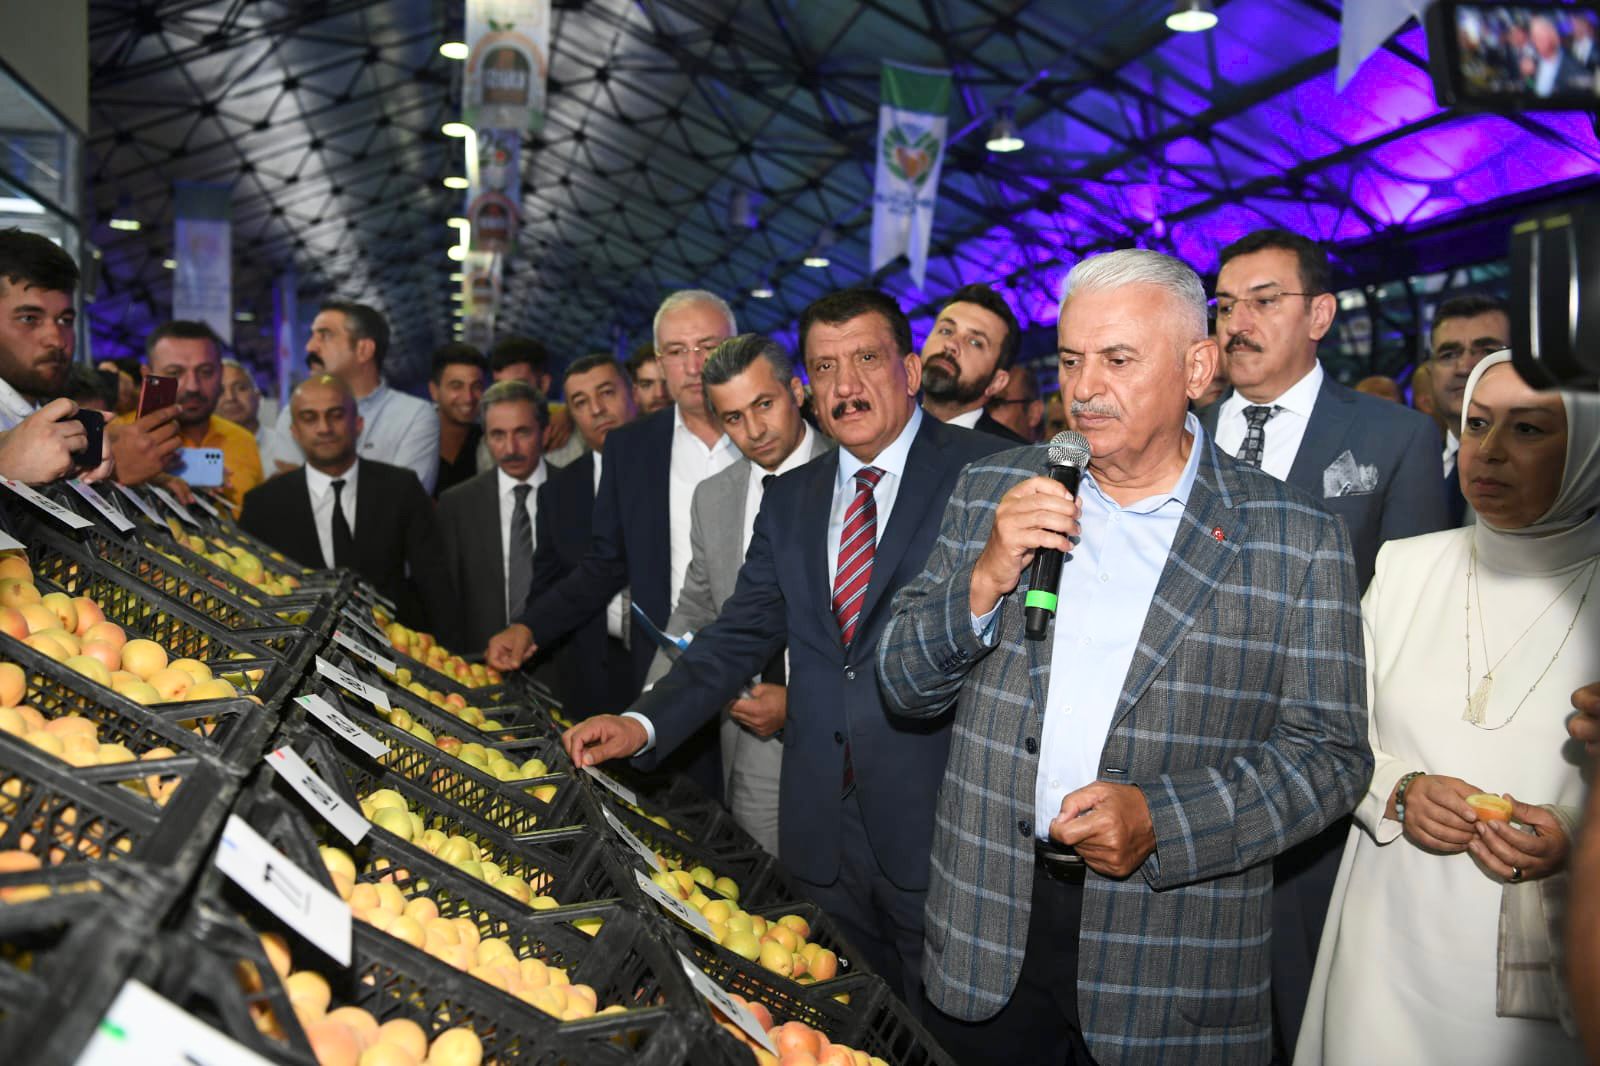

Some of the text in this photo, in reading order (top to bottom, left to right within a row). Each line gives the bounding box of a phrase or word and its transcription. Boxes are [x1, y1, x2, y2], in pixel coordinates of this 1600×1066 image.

[338, 673, 364, 692] 86
[326, 713, 356, 734] 83
[303, 777, 331, 805] 80
[263, 862, 303, 914] 77
